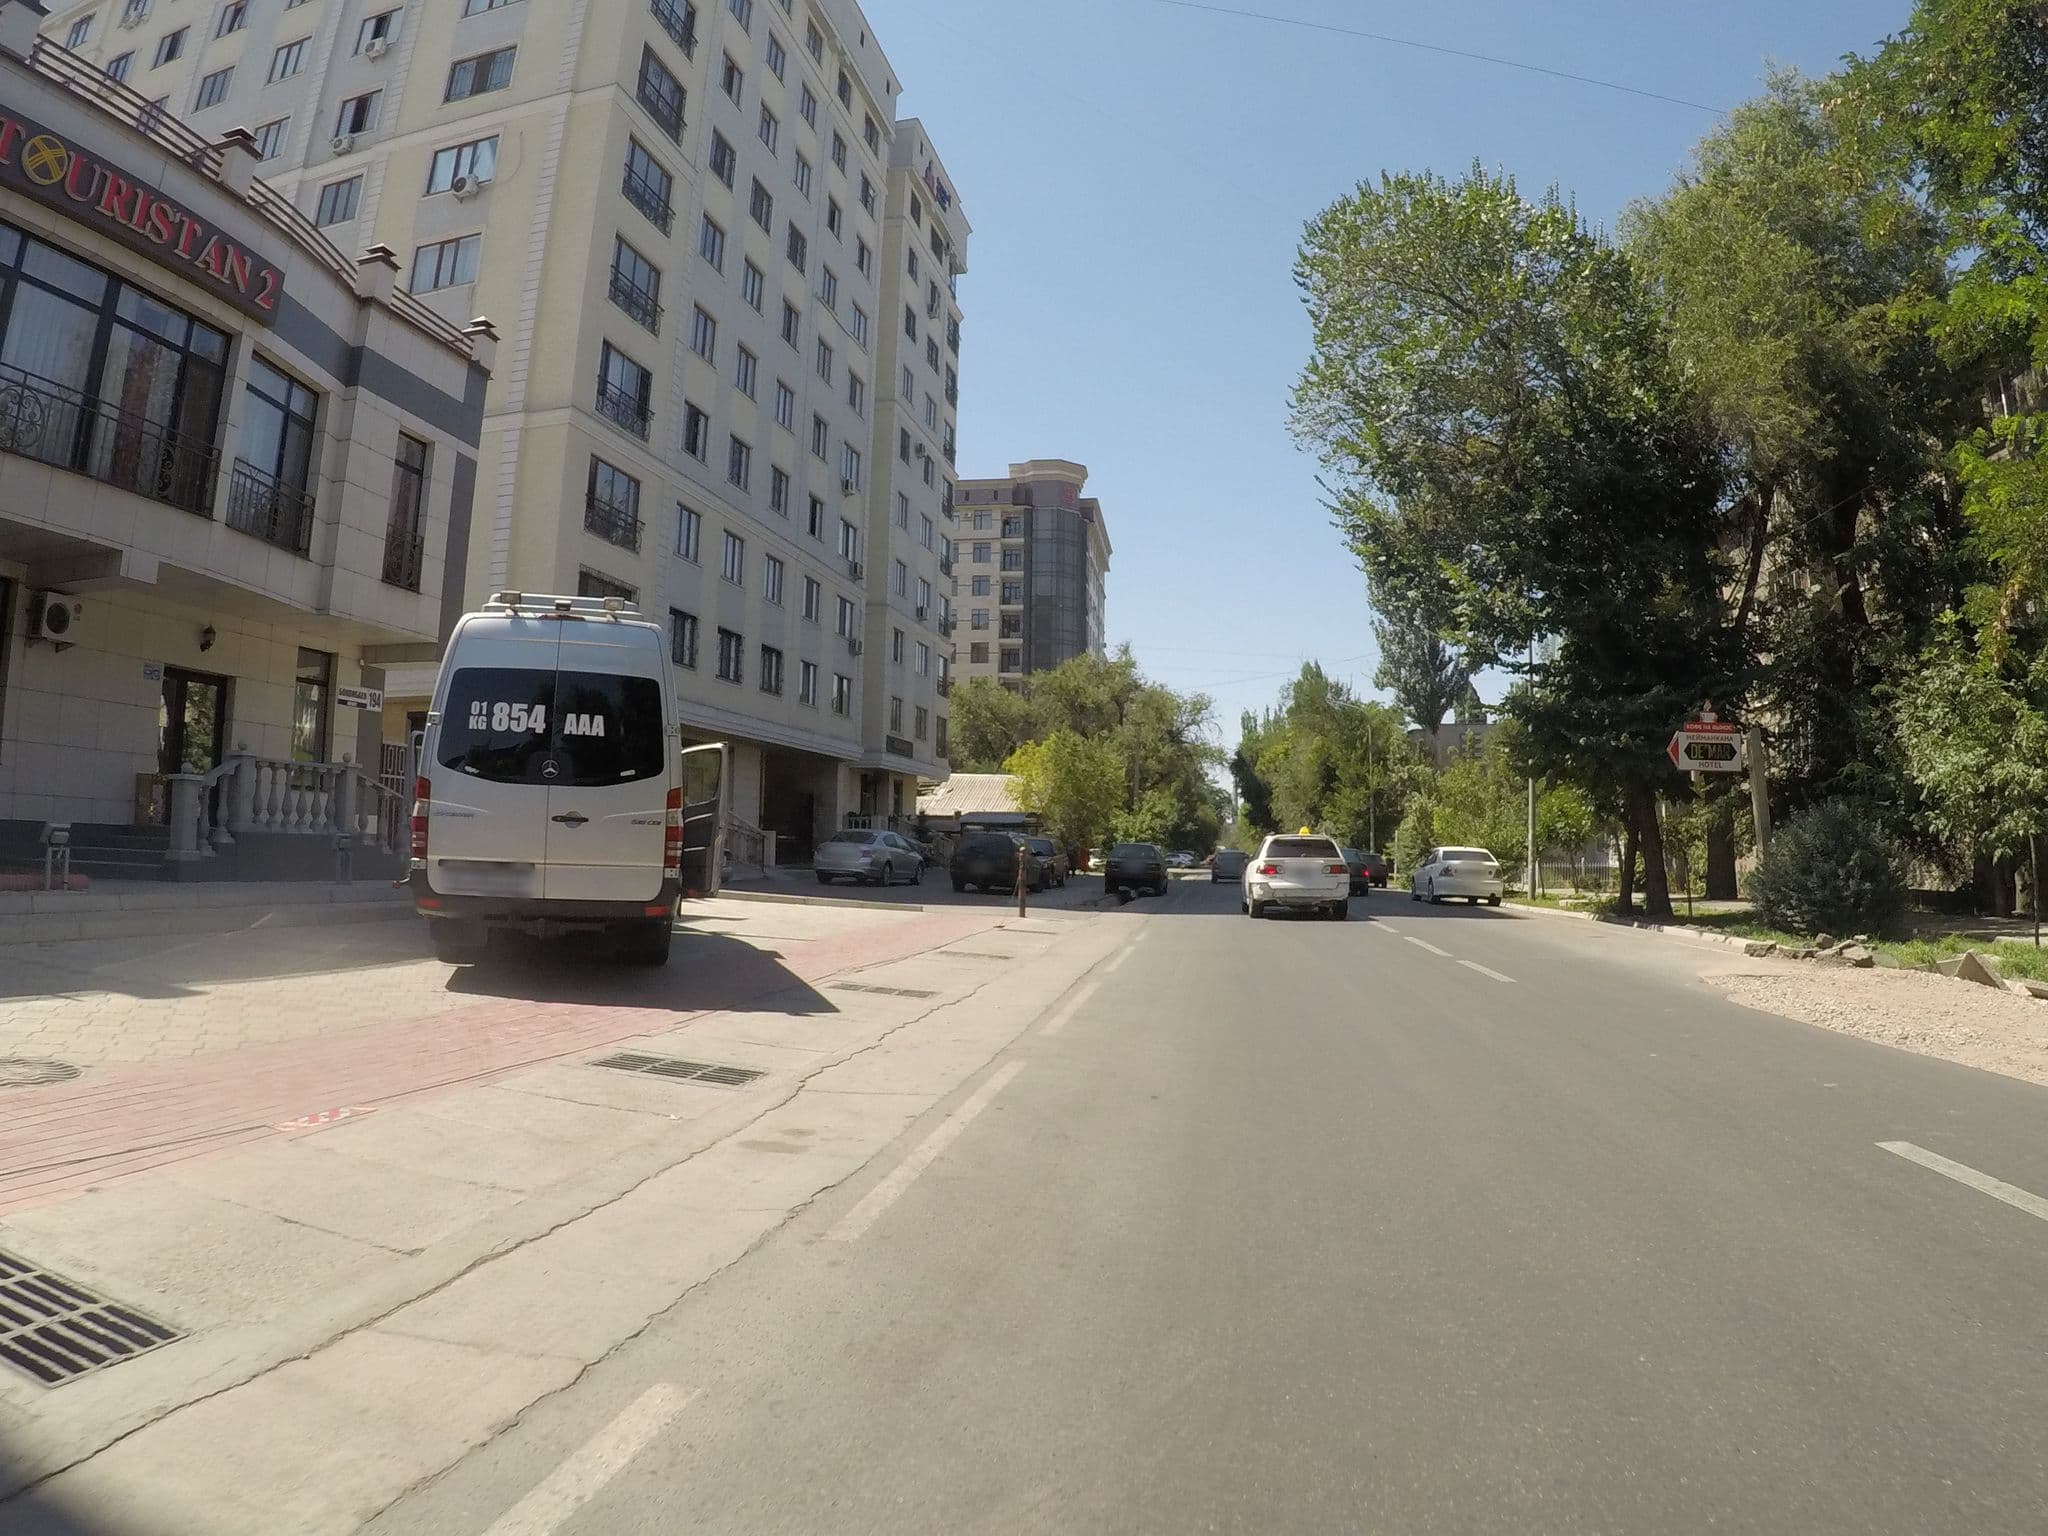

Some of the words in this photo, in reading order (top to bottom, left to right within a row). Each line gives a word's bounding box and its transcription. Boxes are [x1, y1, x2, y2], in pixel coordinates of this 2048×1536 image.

[255, 267, 279, 310] 2
[369, 692, 381, 708] 194
[470, 701, 488, 715] 01
[468, 715, 488, 730] KG
[491, 701, 546, 734] 854
[563, 713, 605, 737] AAA
